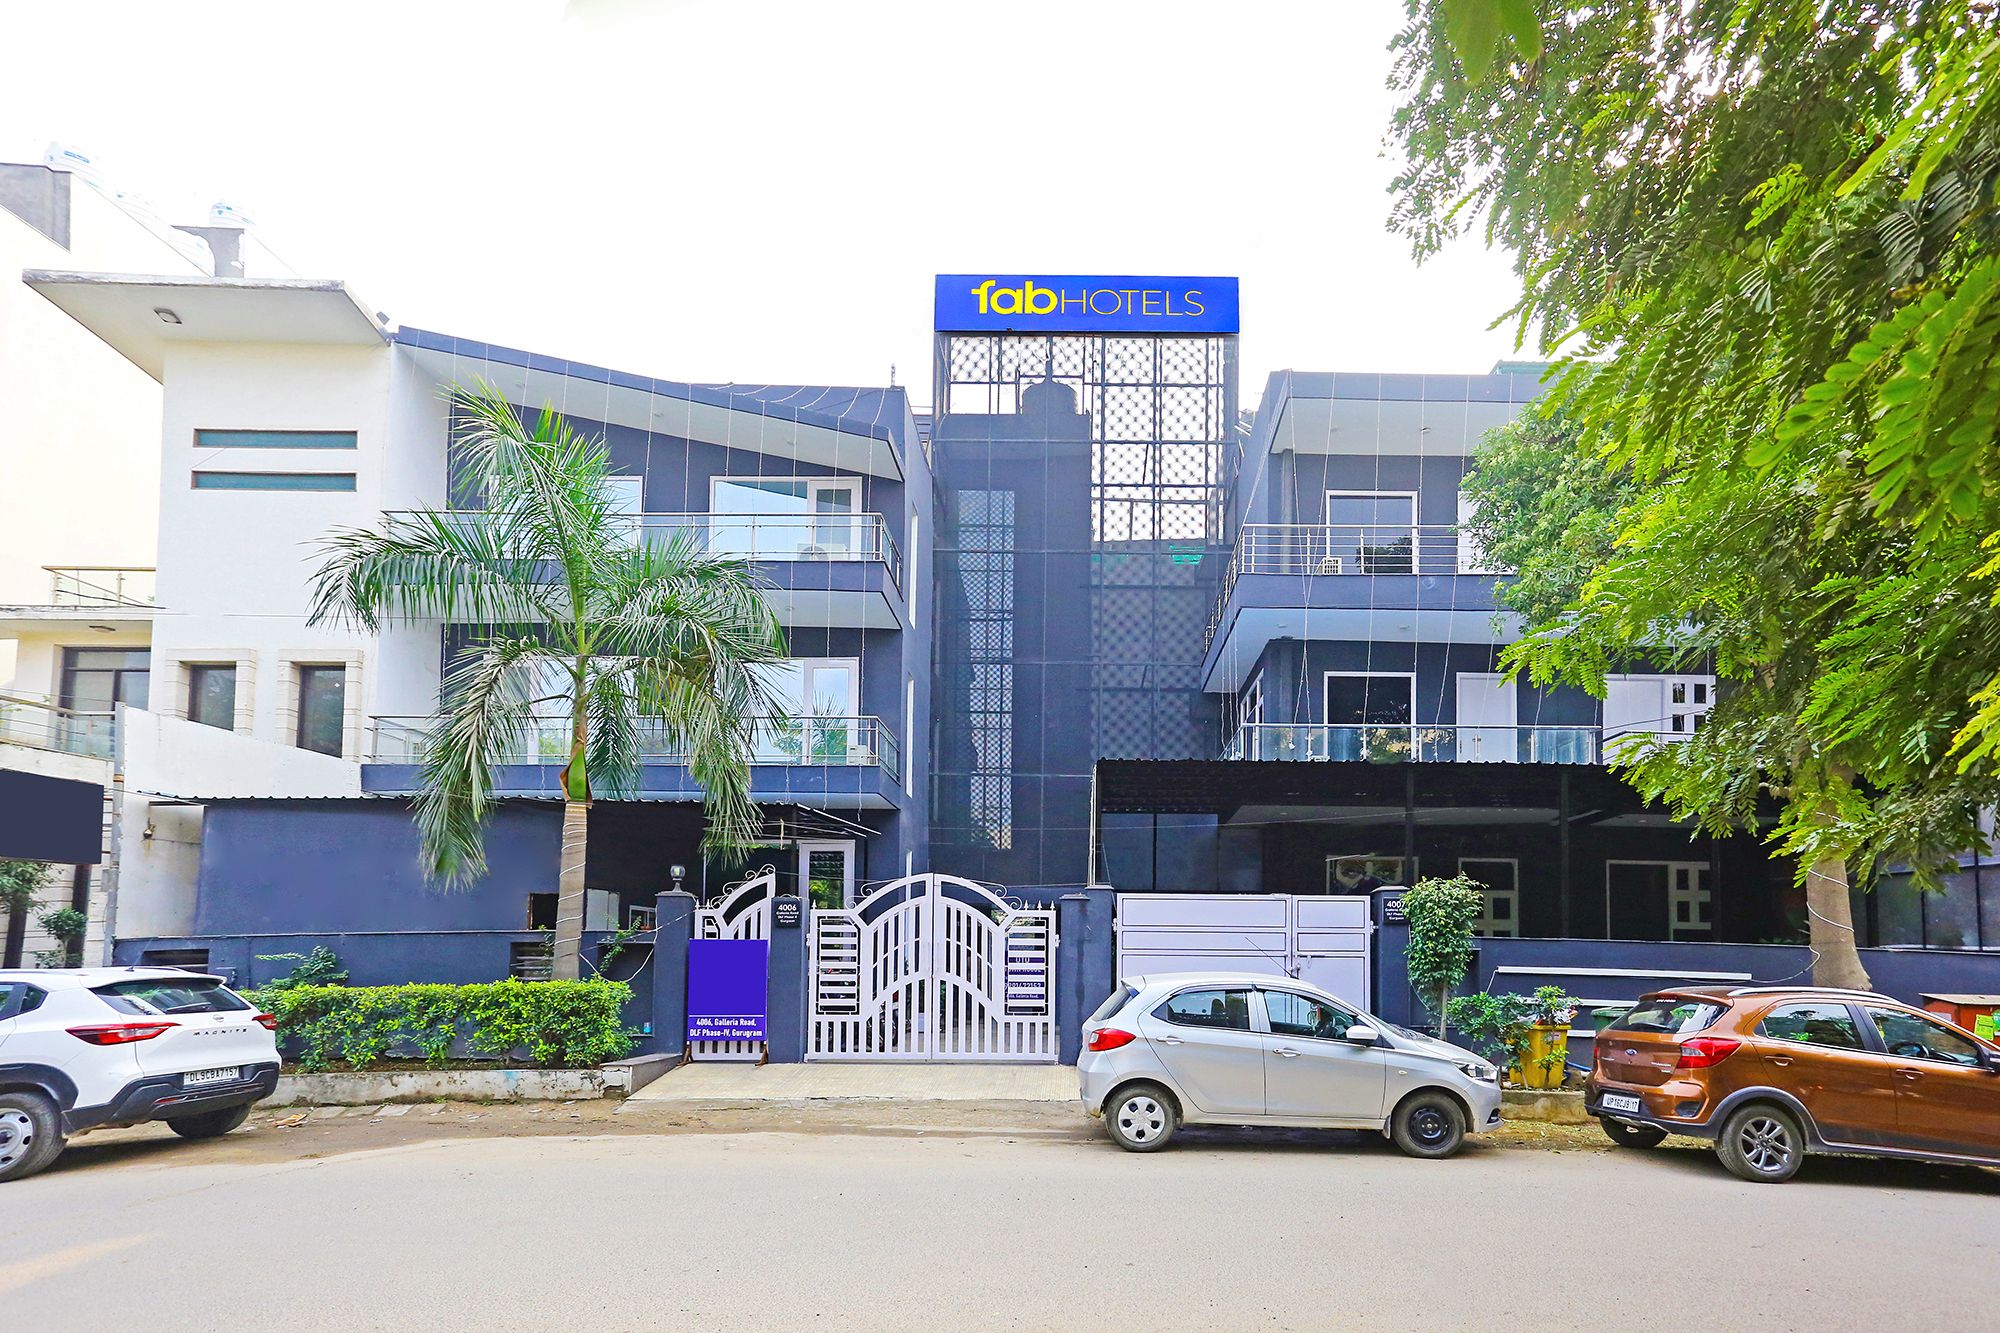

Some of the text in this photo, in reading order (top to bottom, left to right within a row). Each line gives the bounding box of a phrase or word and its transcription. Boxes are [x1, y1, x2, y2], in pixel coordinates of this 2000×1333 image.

[696, 1018, 756, 1026] 4006, Galleria Road,
[702, 1029, 731, 1037] Phase-IV,
[732, 1029, 762, 1038] Gurugram
